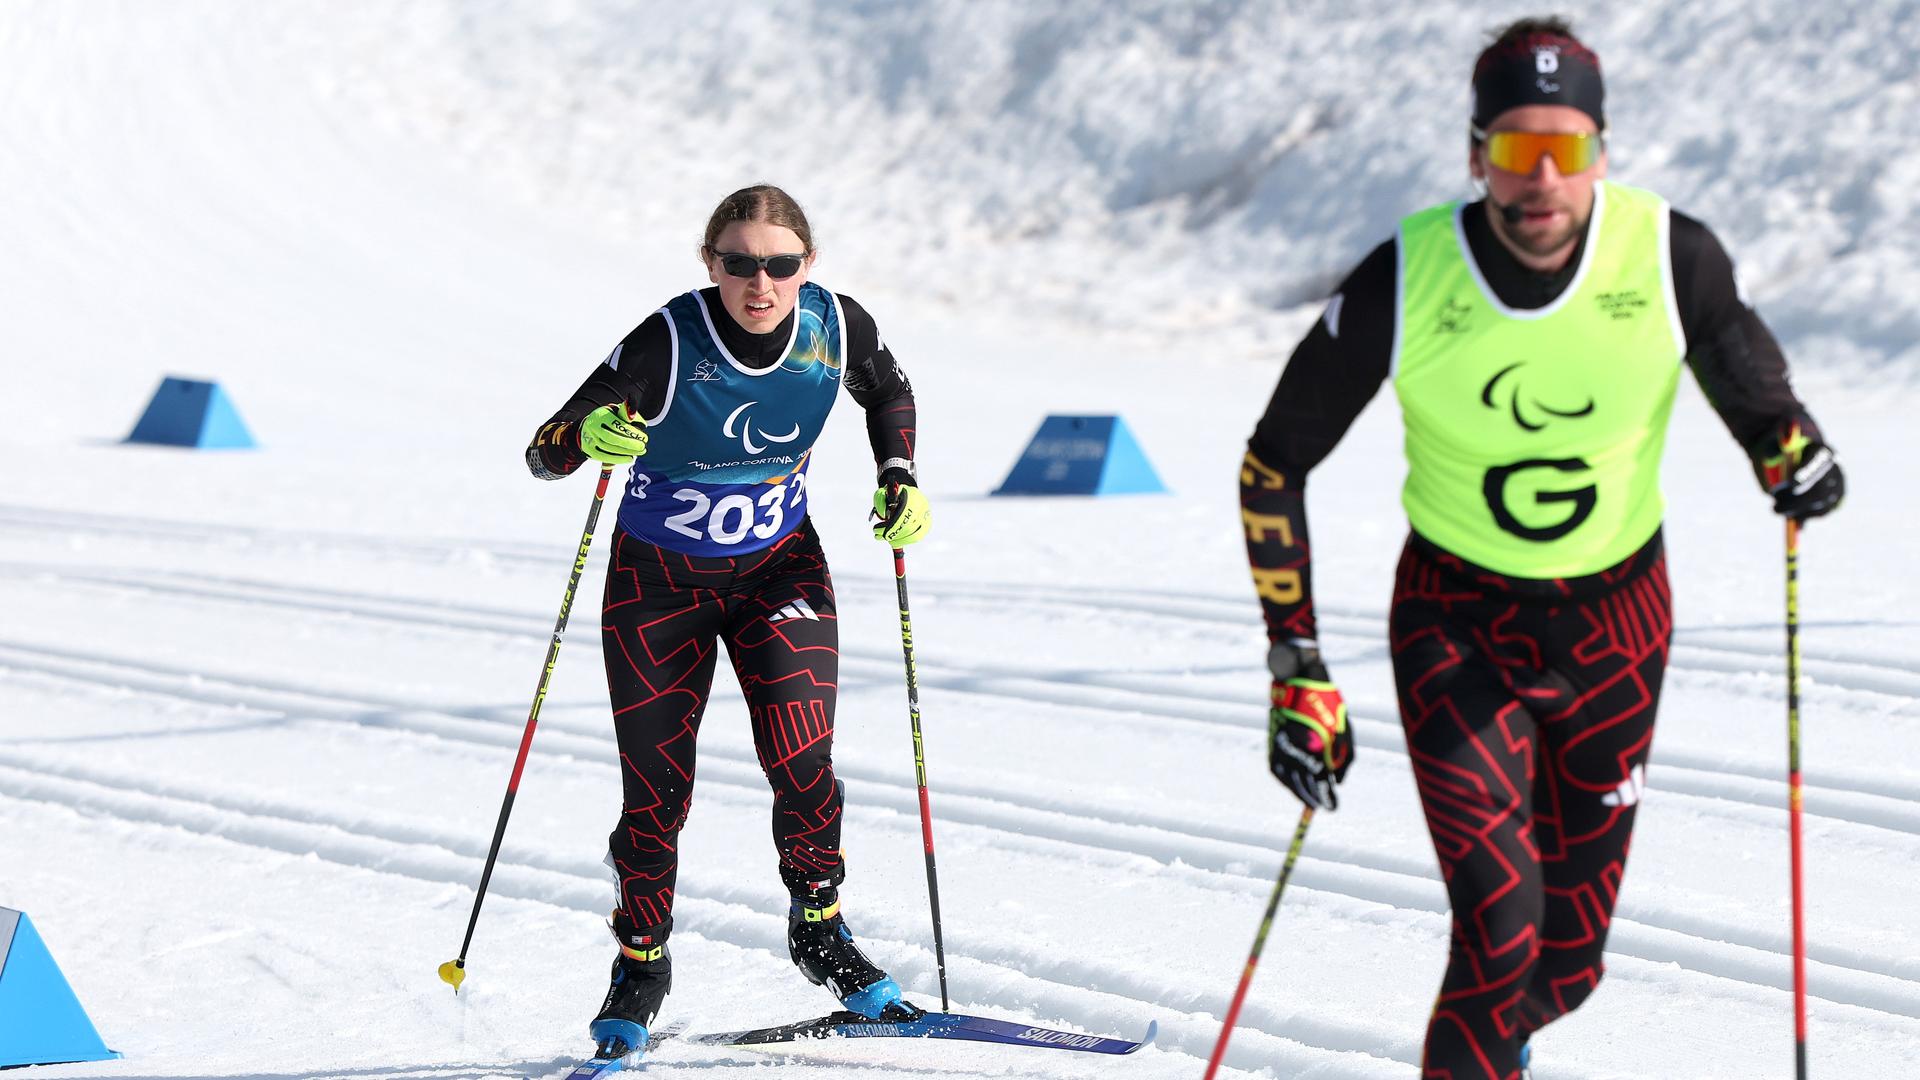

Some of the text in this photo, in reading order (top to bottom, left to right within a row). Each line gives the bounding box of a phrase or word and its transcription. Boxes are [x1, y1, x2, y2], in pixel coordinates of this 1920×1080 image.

[688, 460, 740, 470] MILANO
[742, 455, 794, 465] CORTINA
[664, 485, 788, 545] 203
[1483, 457, 1597, 542] G
[574, 531, 593, 574] LEKI
[847, 1023, 900, 1037] SALOMON
[1016, 1027, 1106, 1049] SALOMON
